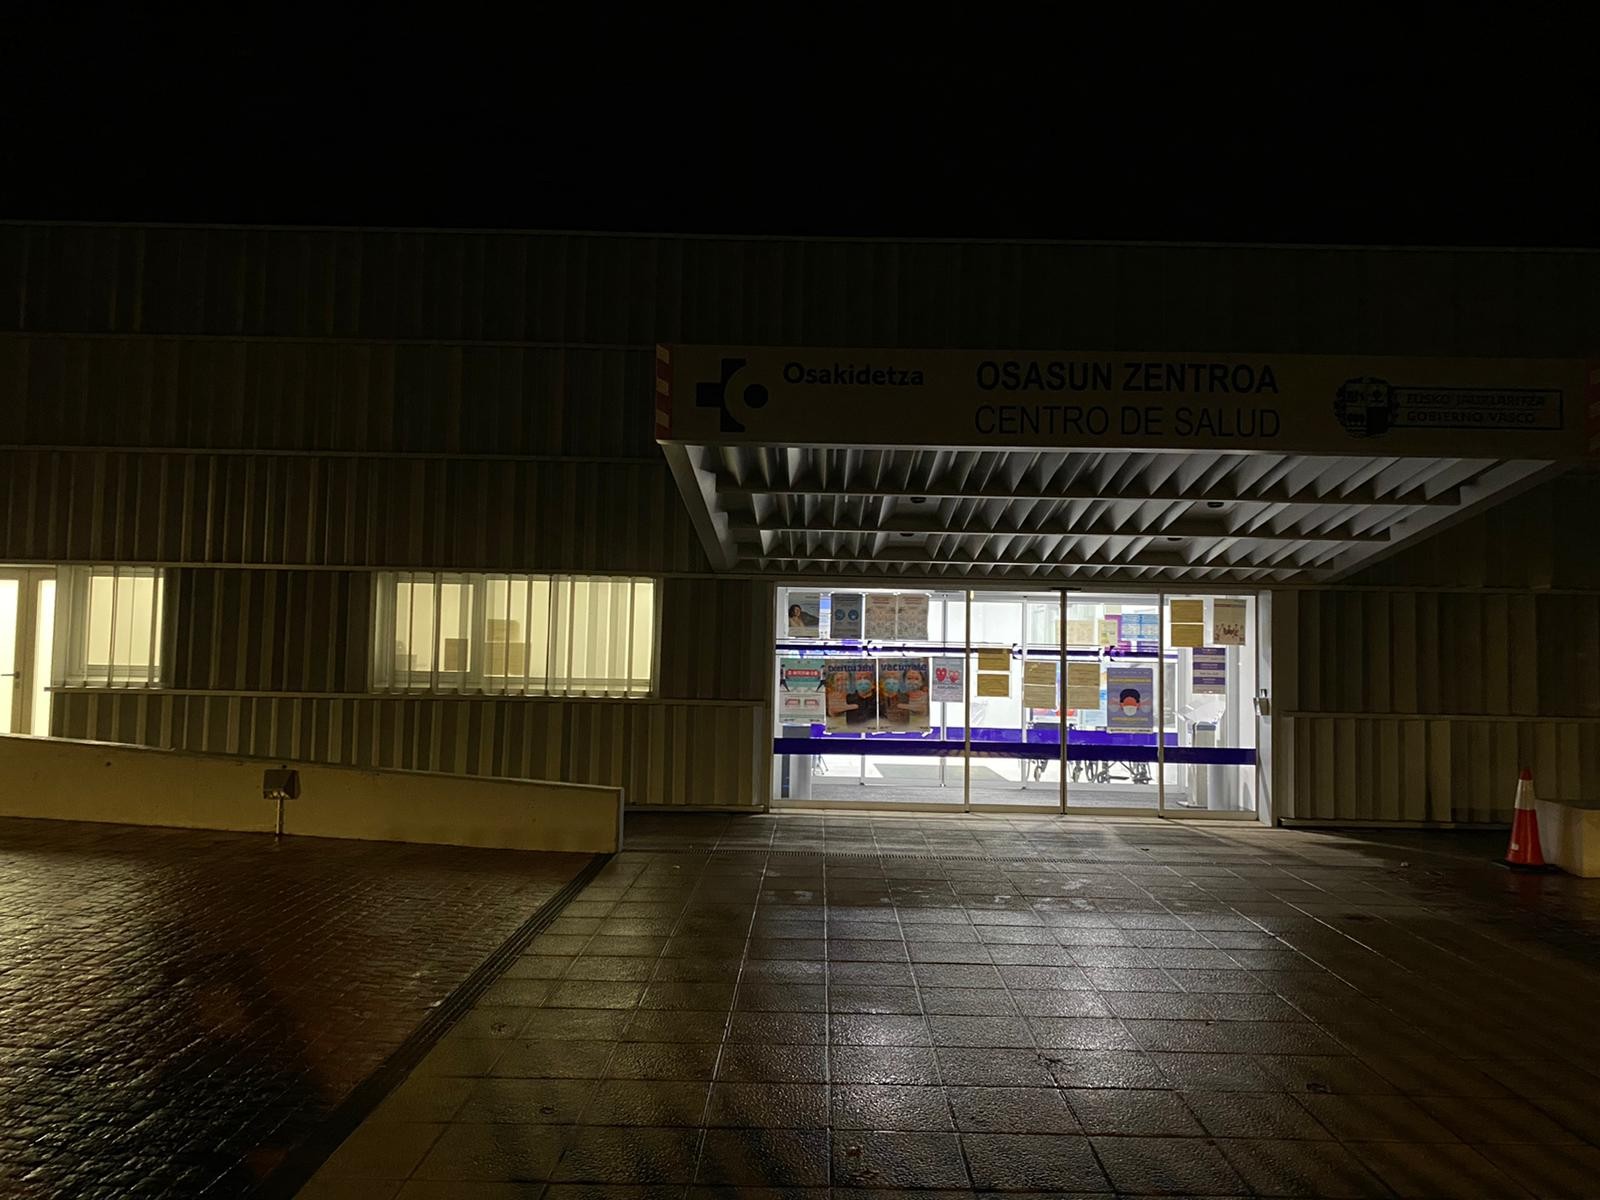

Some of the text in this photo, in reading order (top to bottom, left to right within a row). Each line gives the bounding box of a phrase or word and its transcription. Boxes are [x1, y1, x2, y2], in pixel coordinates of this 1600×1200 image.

[783, 362, 924, 385] Osakidetza
[976, 362, 1278, 394] OSASUN ZENTROA
[975, 406, 1280, 437] CENTRO DE SALUD
[1407, 411, 1536, 425] GOBIERNO VASCO
